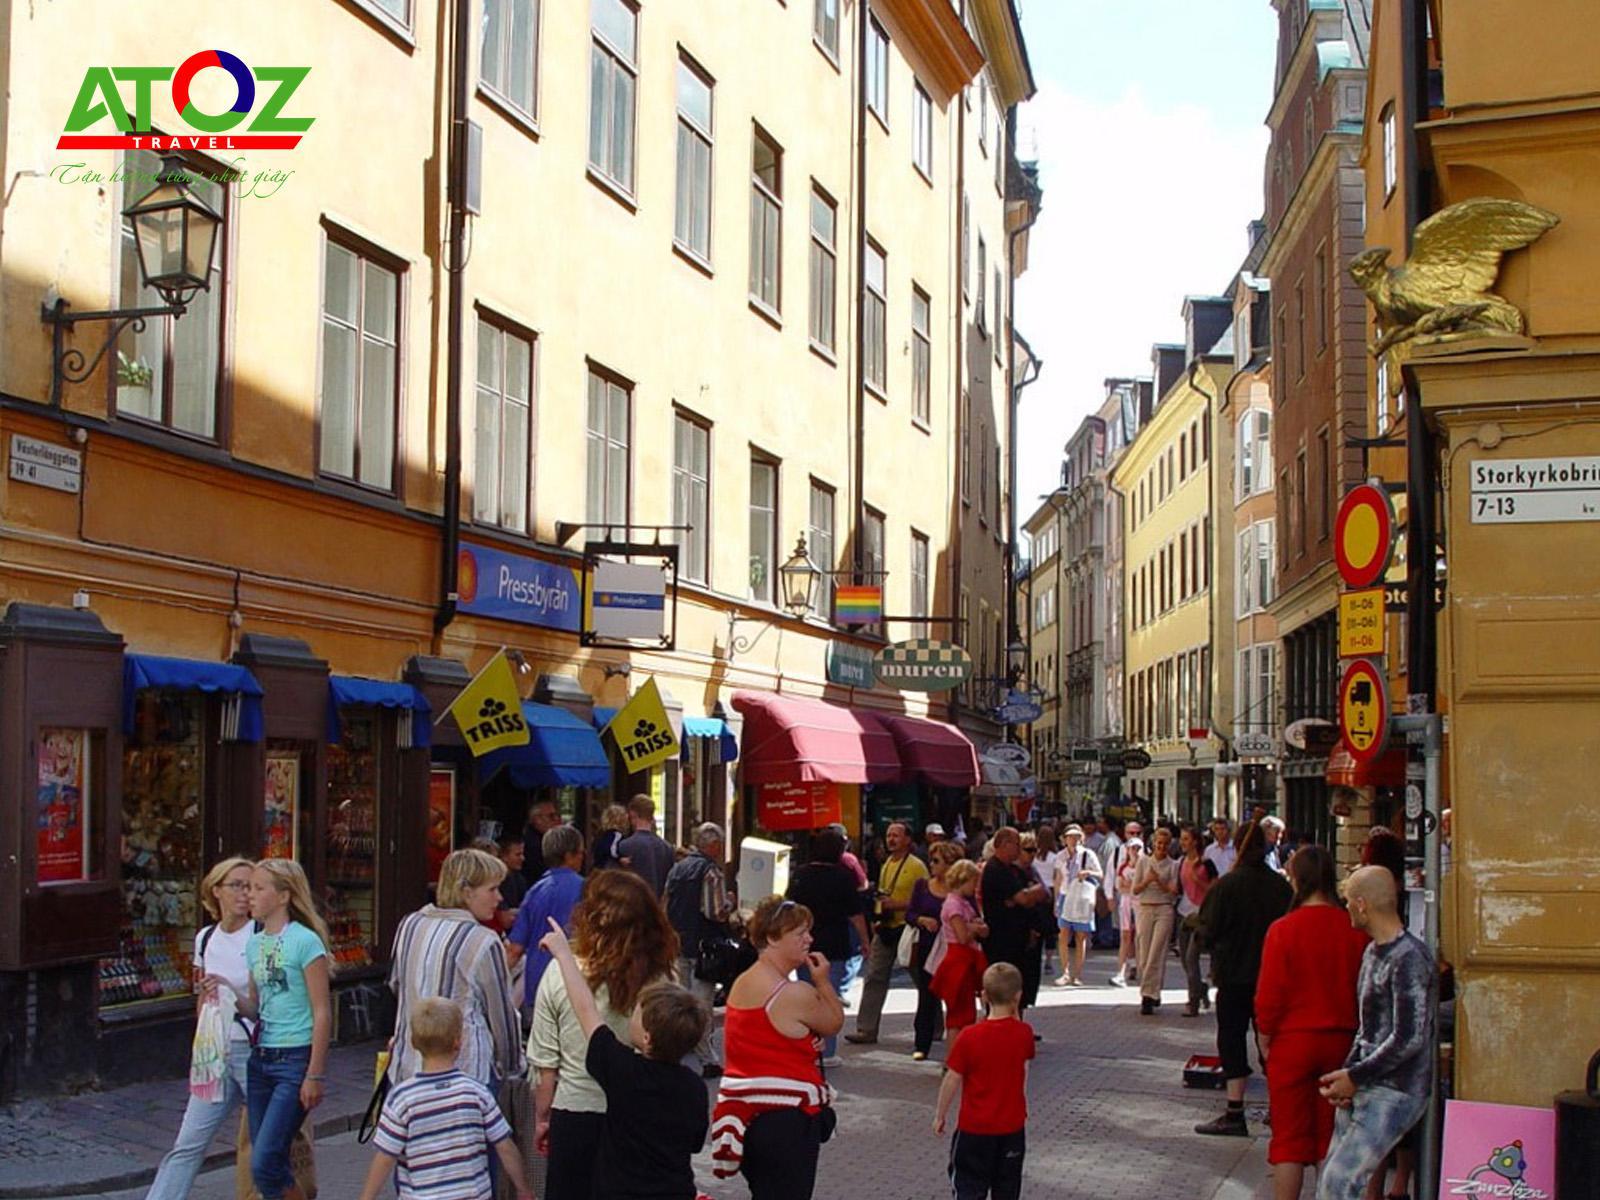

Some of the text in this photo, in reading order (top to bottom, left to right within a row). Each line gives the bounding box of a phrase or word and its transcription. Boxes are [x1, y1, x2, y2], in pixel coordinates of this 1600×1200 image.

[1477, 462, 1600, 488] Storkyrkobri
[1477, 497, 1515, 516] 7-13
[498, 565, 569, 615] Pressbyrån
[881, 664, 964, 678] muren
[466, 713, 524, 743] TRISS
[623, 730, 673, 762] TRISS
